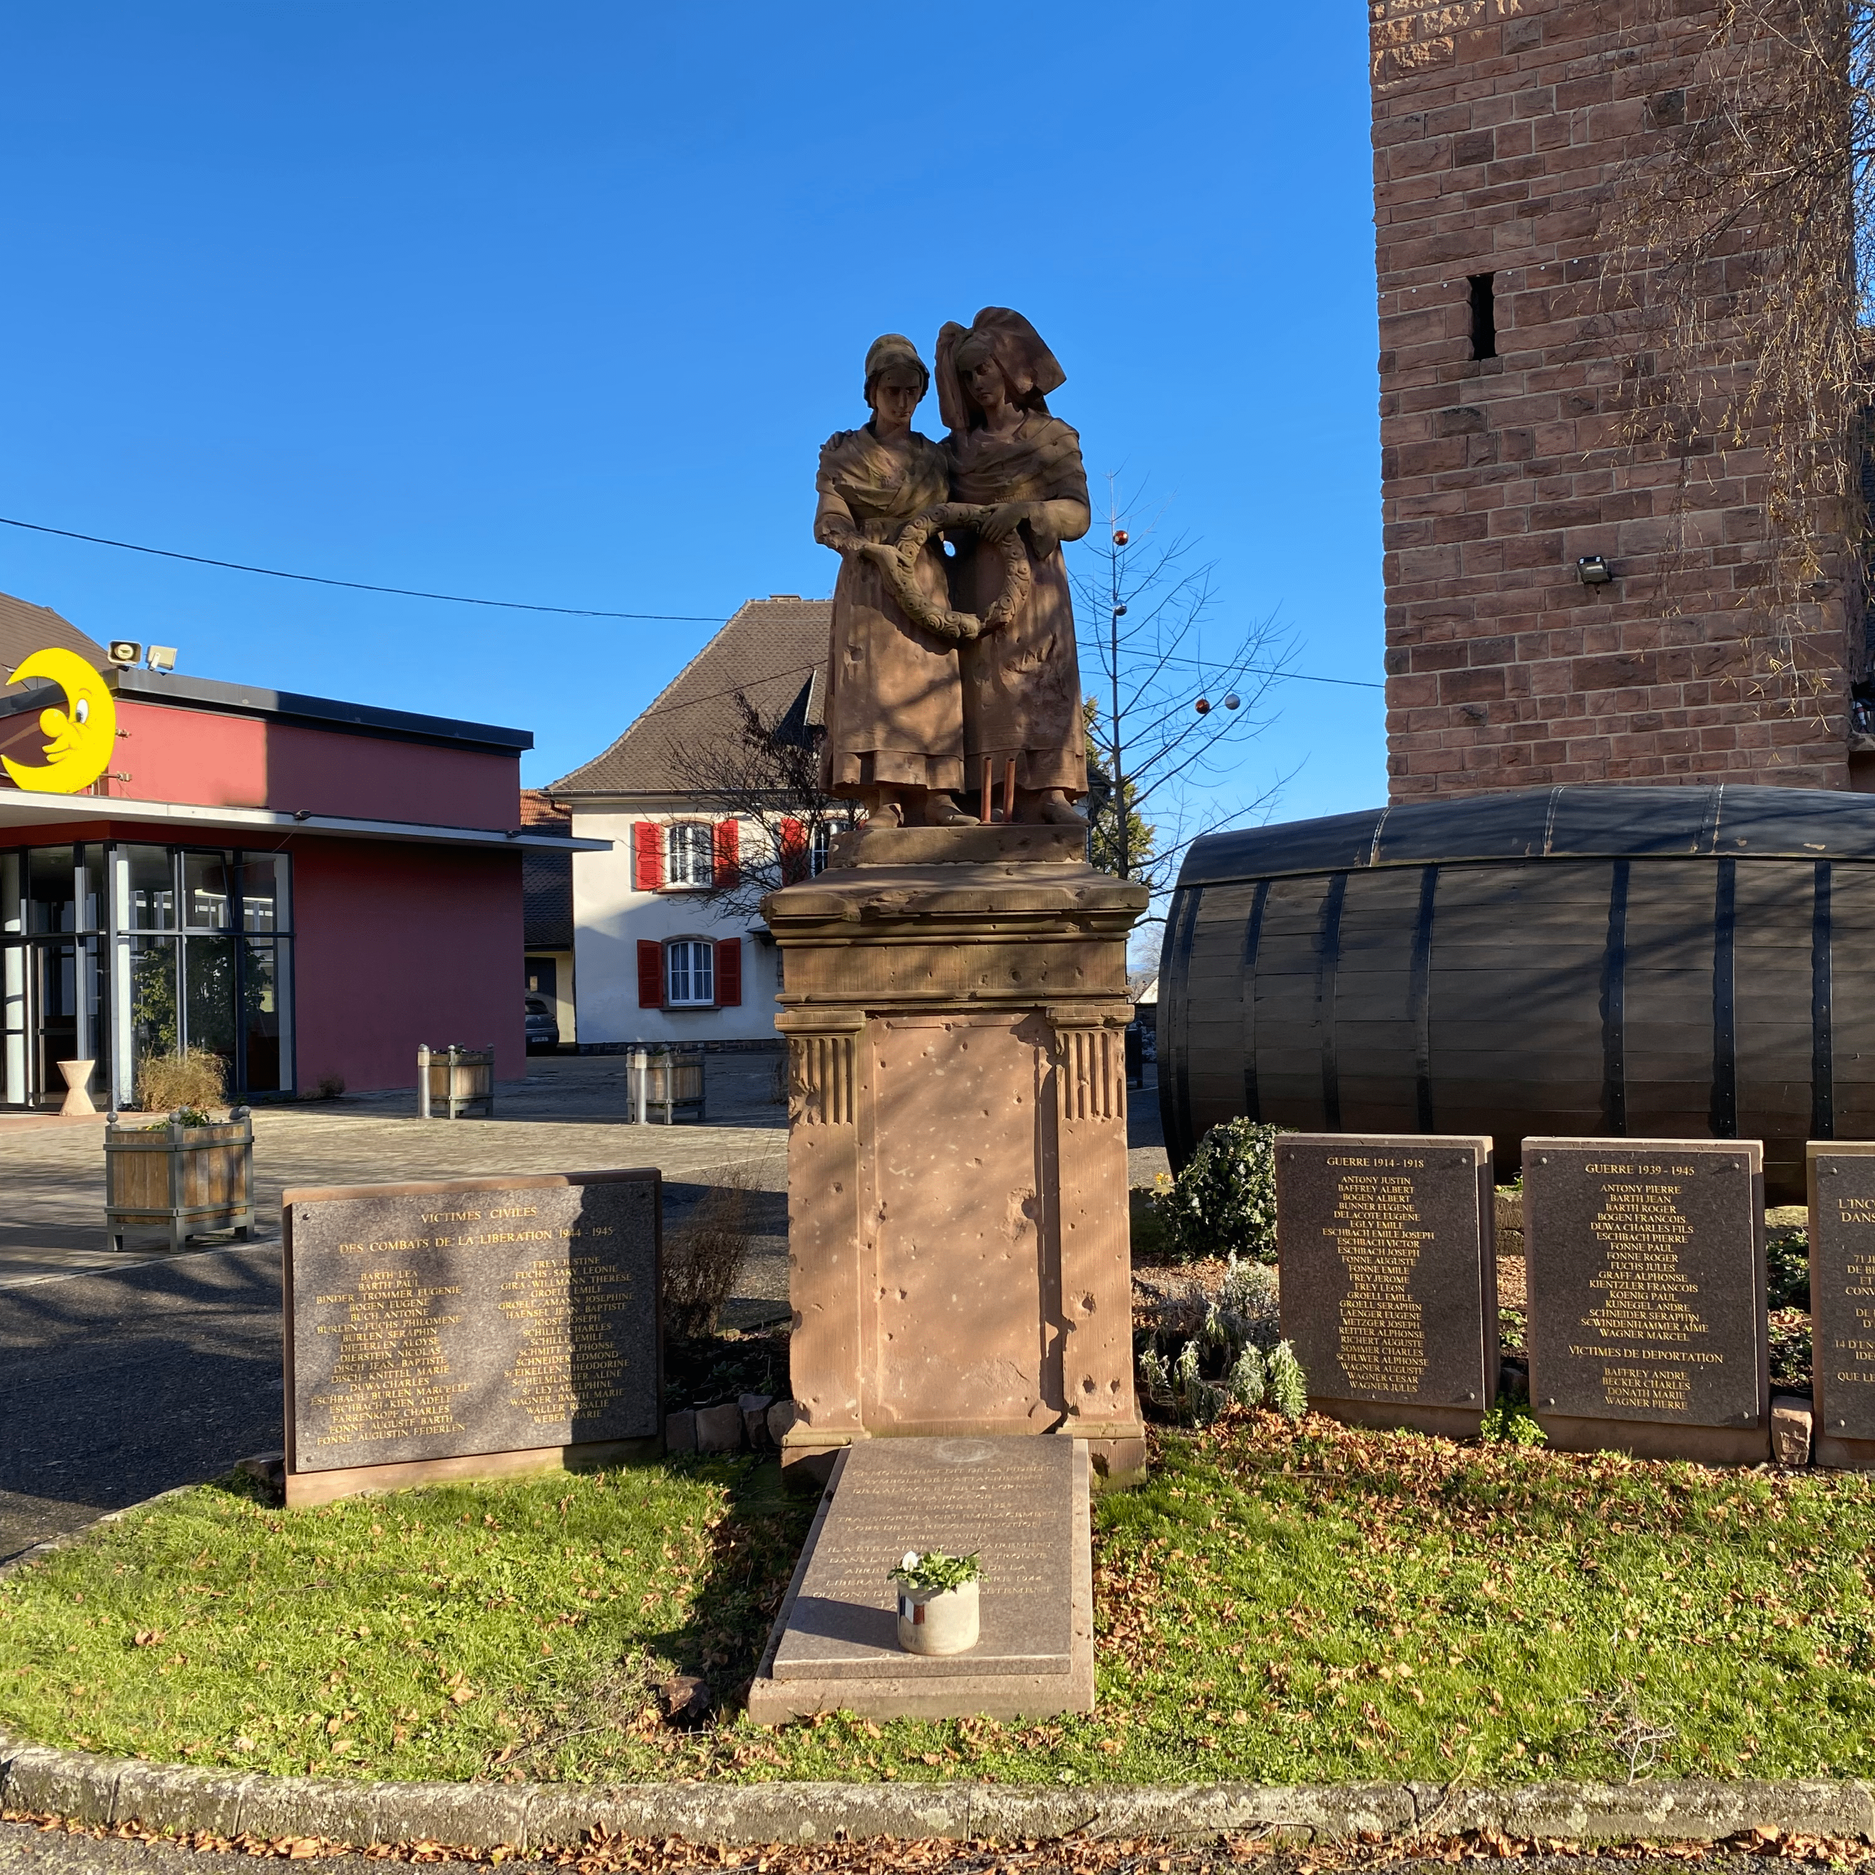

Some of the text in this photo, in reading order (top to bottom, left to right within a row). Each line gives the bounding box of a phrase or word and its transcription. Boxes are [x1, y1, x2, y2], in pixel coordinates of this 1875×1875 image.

[1326, 1157, 1370, 1167] GUERRE
[1373, 1158, 1395, 1167] 1914
[1403, 1159, 1424, 1168] 1918
[1585, 1164, 1634, 1174] GUERRE
[1638, 1165, 1661, 1175] 1939
[1671, 1166, 1695, 1176] 1945
[1341, 1175, 1411, 1185] ANTONY JUSTIN
[1337, 1184, 1415, 1194] BAFFREY ALBERT
[1600, 1184, 1682, 1194] ANTONY PIERRE
[1342, 1193, 1411, 1203] BOGEN ALBERT
[1610, 1194, 1672, 1204] BARTH JEAN
[1338, 1202, 1415, 1212] BUNNER EUGENE
[1605, 1203, 1677, 1214] BARTH ROGER
[421, 1207, 537, 1224] VICTIMES CIVILES
[1333, 1210, 1421, 1221] DELACOTE EUGENE
[1597, 1213, 1686, 1224] BOGEN FRANCOIS
[1350, 1220, 1404, 1230] EGLY EMILE
[1590, 1222, 1694, 1234] DUWA CHARLES FILS
[339, 1242, 363, 1254] DES
[370, 1239, 429, 1252] COMBATS
[435, 1237, 453, 1248] DE
[458, 1236, 474, 1246] LA
[480, 1230, 552, 1244] LIBERATION
[559, 1228, 581, 1239] 1944
[592, 1226, 614, 1237] 1945
[1322, 1228, 1435, 1240] ESCHBACH EMILE JOSEPH
[1596, 1232, 1689, 1243] ESCHBACH PIERRE
[1337, 1246, 1420, 1258] ESCHBACH JOSEPH
[1610, 1242, 1674, 1253] FONNE PAUL
[1341, 1255, 1416, 1267] FONNE AUGUSTE
[1606, 1252, 1679, 1262] FONNE ROGER
[1854, 1254, 1864, 1264] 71
[1610, 1261, 1676, 1272] FUCHS JULES
[1847, 1265, 1862, 1274] DE
[1349, 1273, 1410, 1284] FREY JEROME
[1598, 1271, 1688, 1282] GRAFF ALPHONSE
[1860, 1276, 1873, 1285] ET
[360, 1279, 419, 1291] BARTH PAUL
[1354, 1282, 1405, 1293] FREY LEON
[1589, 1279, 1699, 1293] KIENTZLER FRANCOIS
[531, 1285, 602, 1298] GROELL EMILE
[1347, 1291, 1414, 1302] GROELL EMILE
[1610, 1290, 1679, 1302] KOENIG PAUL
[350, 1298, 430, 1312] BOGEN EUGENE
[1339, 1300, 1422, 1311] GROELL SERAPHIN
[1605, 1299, 1691, 1312] KUNEGEL ANDRE
[351, 1308, 429, 1322] BUCH ANTOINE
[1340, 1308, 1422, 1320] LAENGER EUGENE
[1589, 1308, 1700, 1322] SCHNEIDER SERAPHIN
[1342, 1317, 1420, 1329] METZGER JOSEPH
[1581, 1317, 1709, 1333] SCWINDENHAMMER AIME
[342, 1327, 438, 1343] BURLEN SERAPHIN
[1338, 1326, 1425, 1339] REITTER ALPHONSE
[1599, 1328, 1690, 1342] WAGNER MARCEL
[530, 1332, 604, 1346] SCHILLE EMILE
[1340, 1335, 1424, 1348] RICHERT AUGUSTE
[1835, 1339, 1845, 1348] 14
[1341, 1345, 1424, 1357] SOMMER CHARLES
[1568, 1345, 1723, 1364] VICTIMES DE DEPORTATION
[334, 1356, 447, 1374] DISCH JEAN BAPTISTE
[516, 1351, 619, 1367] SCHNEIDER EDMOND
[1336, 1353, 1429, 1366] SCHUWER ALPHONSE
[1340, 1362, 1425, 1375] WAGNER AUGUSTE
[1604, 1367, 1688, 1380] BAFFREY ANDRE
[1347, 1371, 1419, 1384] WAGNER CESAR
[1837, 1371, 1860, 1382] QUE
[350, 1377, 430, 1392] DUWA CHARLES
[1602, 1377, 1691, 1391] BECKER CHARLES
[1607, 1387, 1686, 1400] DONATH MARIE
[526, 1399, 610, 1415] WALLER ROSALIE
[1604, 1396, 1688, 1410] WAGNER PIERRE
[333, 1404, 450, 1424] FARRENKOPF CHARLES
[533, 1409, 602, 1424] WEBER MARIE
[330, 1414, 453, 1434] FONNE AUGUSTE BARTH
[317, 1423, 465, 1445] FONNE AUGUSTIN FEDERLEN
